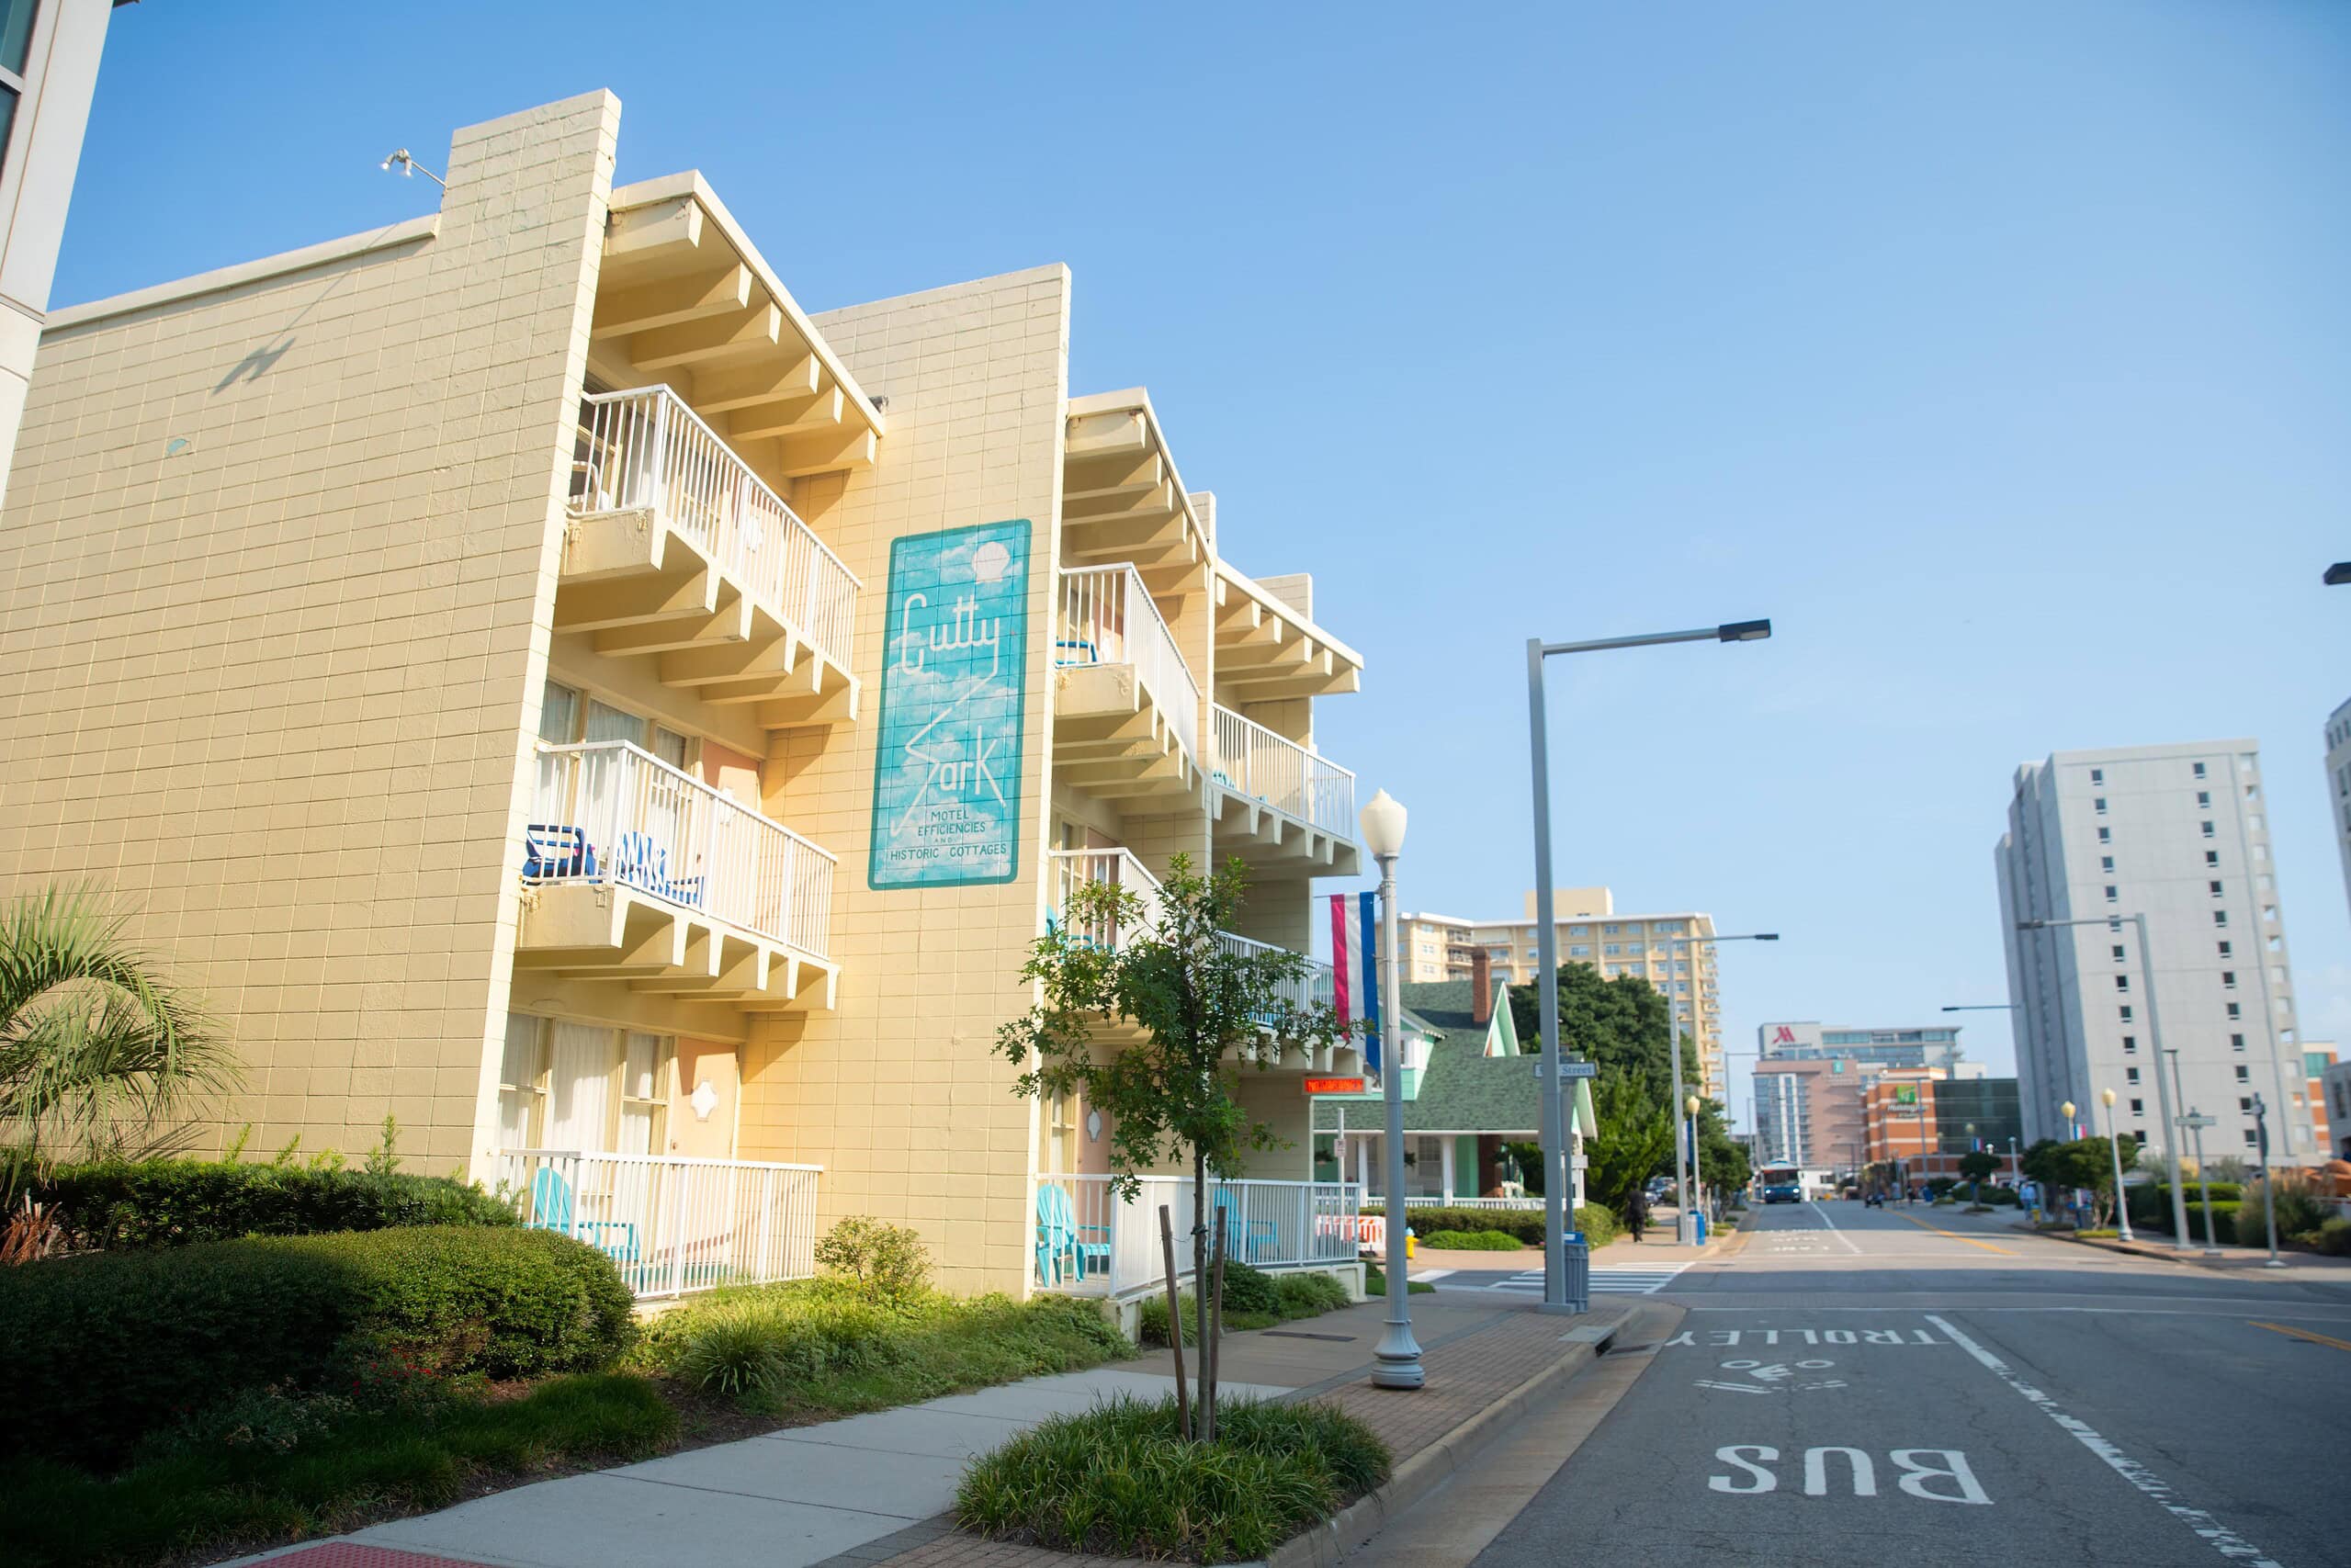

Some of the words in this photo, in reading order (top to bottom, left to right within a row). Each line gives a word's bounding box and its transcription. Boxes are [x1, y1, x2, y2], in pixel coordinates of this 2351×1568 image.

[900, 592, 1000, 691] Cutty
[889, 707, 1007, 837] Sark
[931, 809, 970, 822] MOTEL
[918, 821, 986, 837] EFFICIENCIES
[890, 848, 940, 861] HISTORIC
[949, 843, 1007, 858] COTTAGES
[1562, 1065, 1591, 1074] Street
[1665, 1329, 1951, 1347] TROLLEY
[1709, 1445, 1995, 1504] BUS
